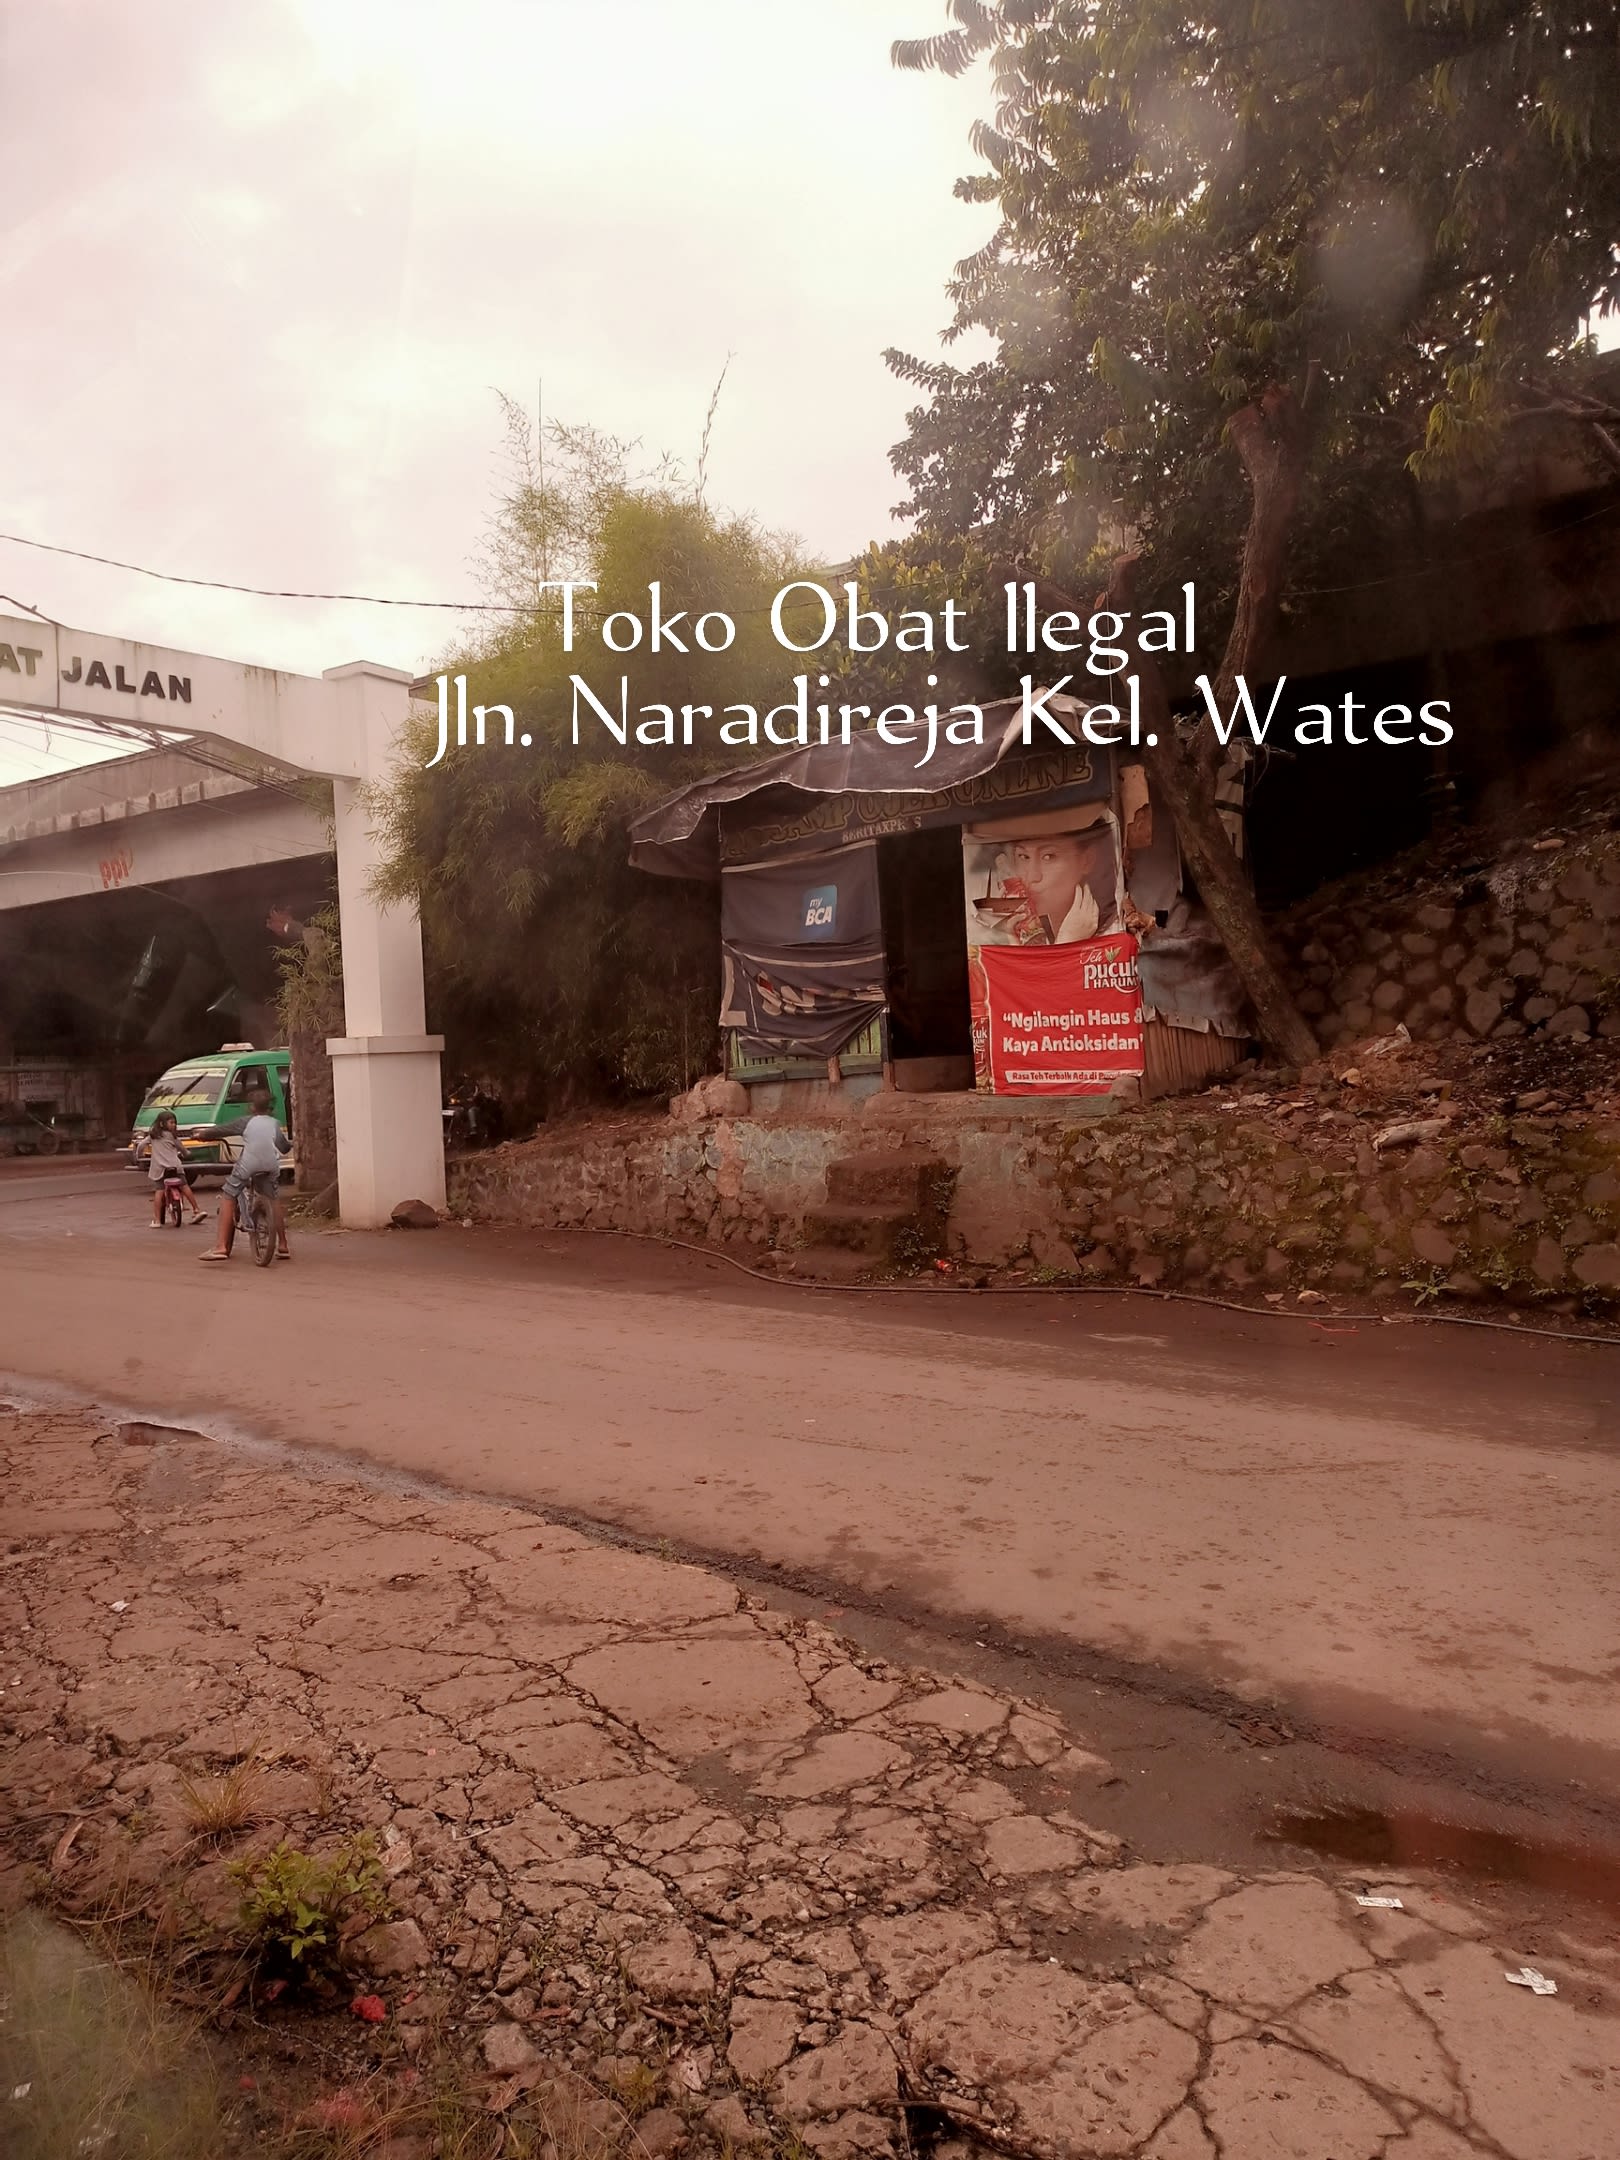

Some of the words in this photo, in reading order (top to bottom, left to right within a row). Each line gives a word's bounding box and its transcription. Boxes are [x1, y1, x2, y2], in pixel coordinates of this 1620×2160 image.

[61, 656, 192, 703] JALAN
[809, 897, 823, 908] my
[805, 906, 832, 926] BCA
[1093, 977, 1137, 989] HARUM
[1087, 1009, 1130, 1026] Haus
[1003, 1037, 1039, 1056] Kaya
[1012, 1072, 1029, 1080] Rasa
[1030, 1072, 1044, 1080] Teh
